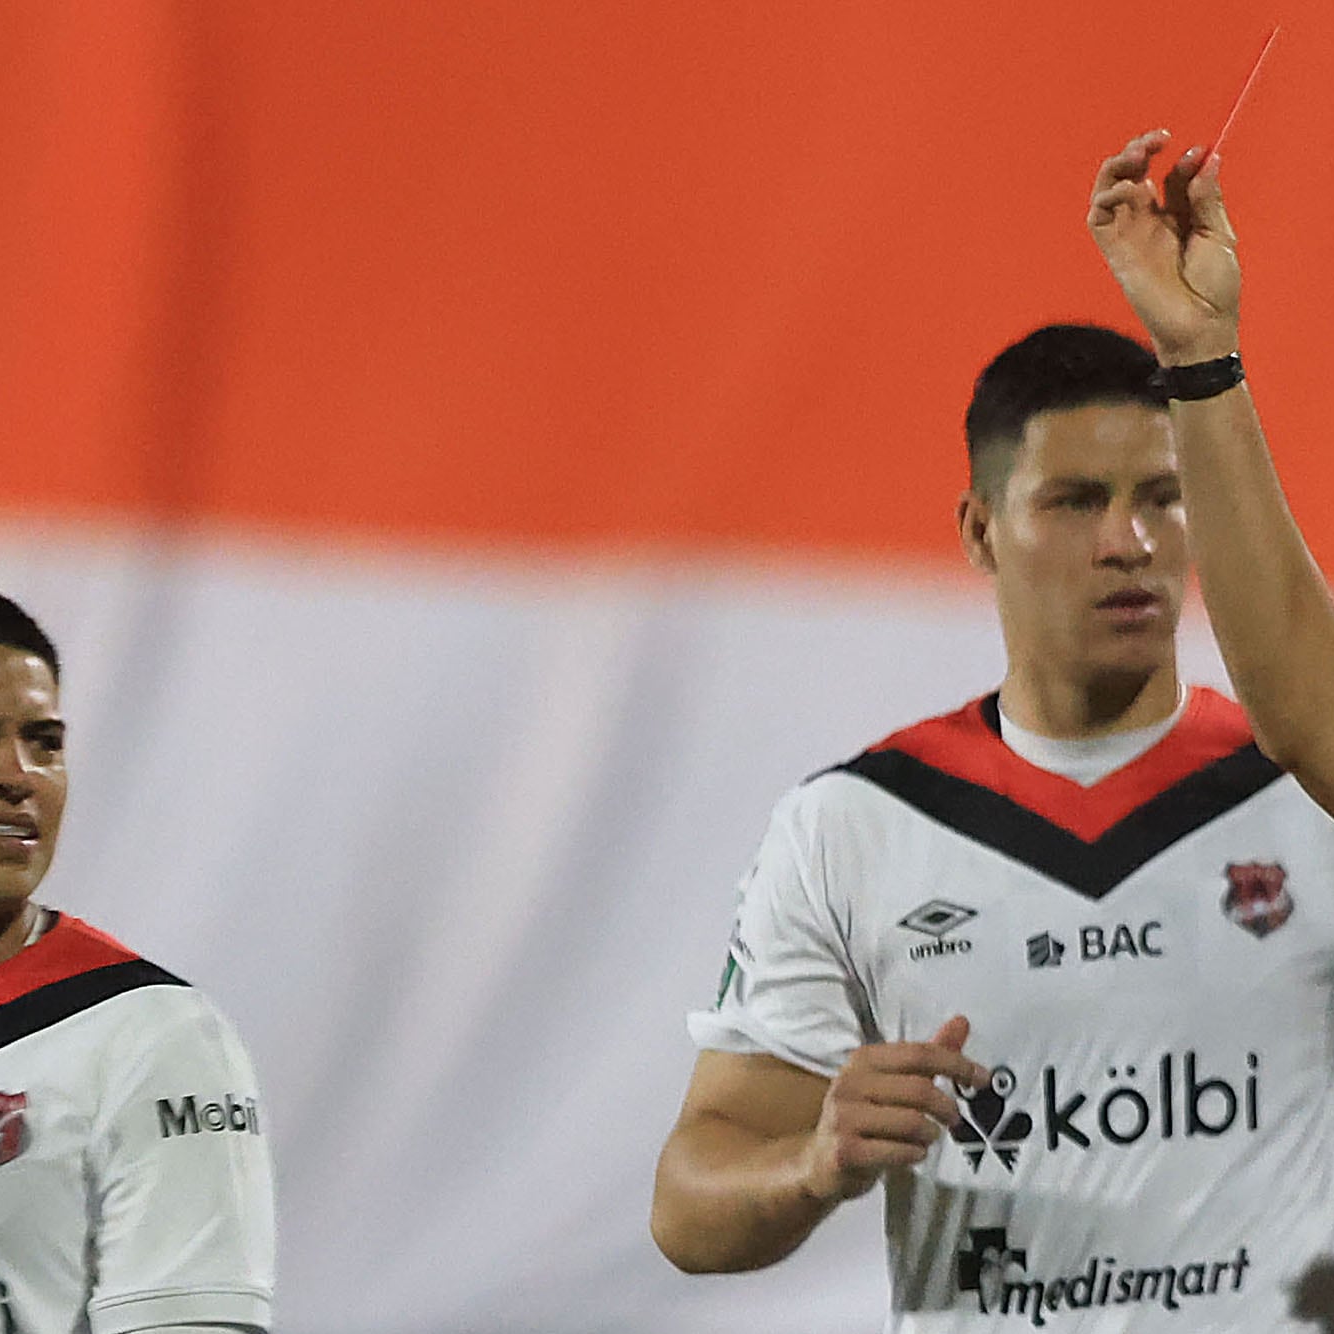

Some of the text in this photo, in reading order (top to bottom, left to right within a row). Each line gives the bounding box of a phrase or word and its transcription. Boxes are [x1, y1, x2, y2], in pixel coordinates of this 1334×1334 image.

[1079, 921, 1163, 962] BAC
[1042, 1050, 1258, 1151] kölbi
[999, 1246, 1251, 1326] medismart
